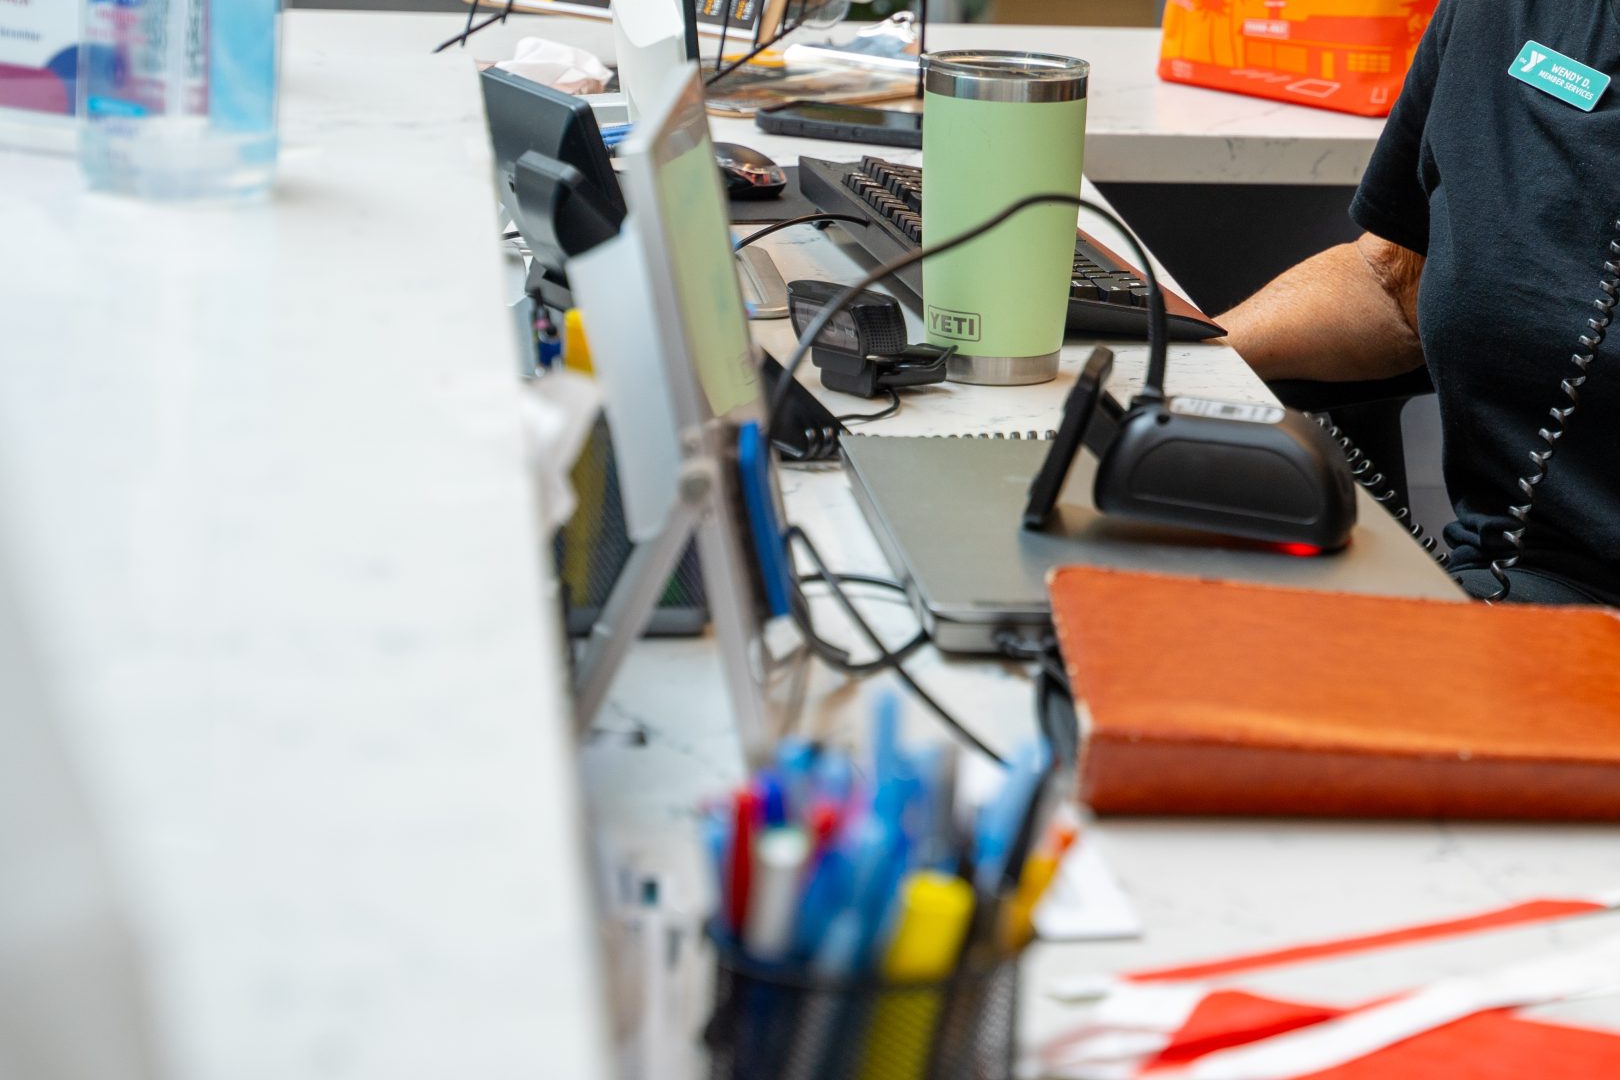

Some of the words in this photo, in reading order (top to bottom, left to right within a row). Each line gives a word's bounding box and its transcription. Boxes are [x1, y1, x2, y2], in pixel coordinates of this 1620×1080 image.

[1538, 70, 1565, 88] MEMBER
[1564, 82, 1595, 101] SERVICES
[1551, 63, 1583, 83] WENDY
[1581, 78, 1591, 90] D.
[930, 311, 975, 336] YETI
